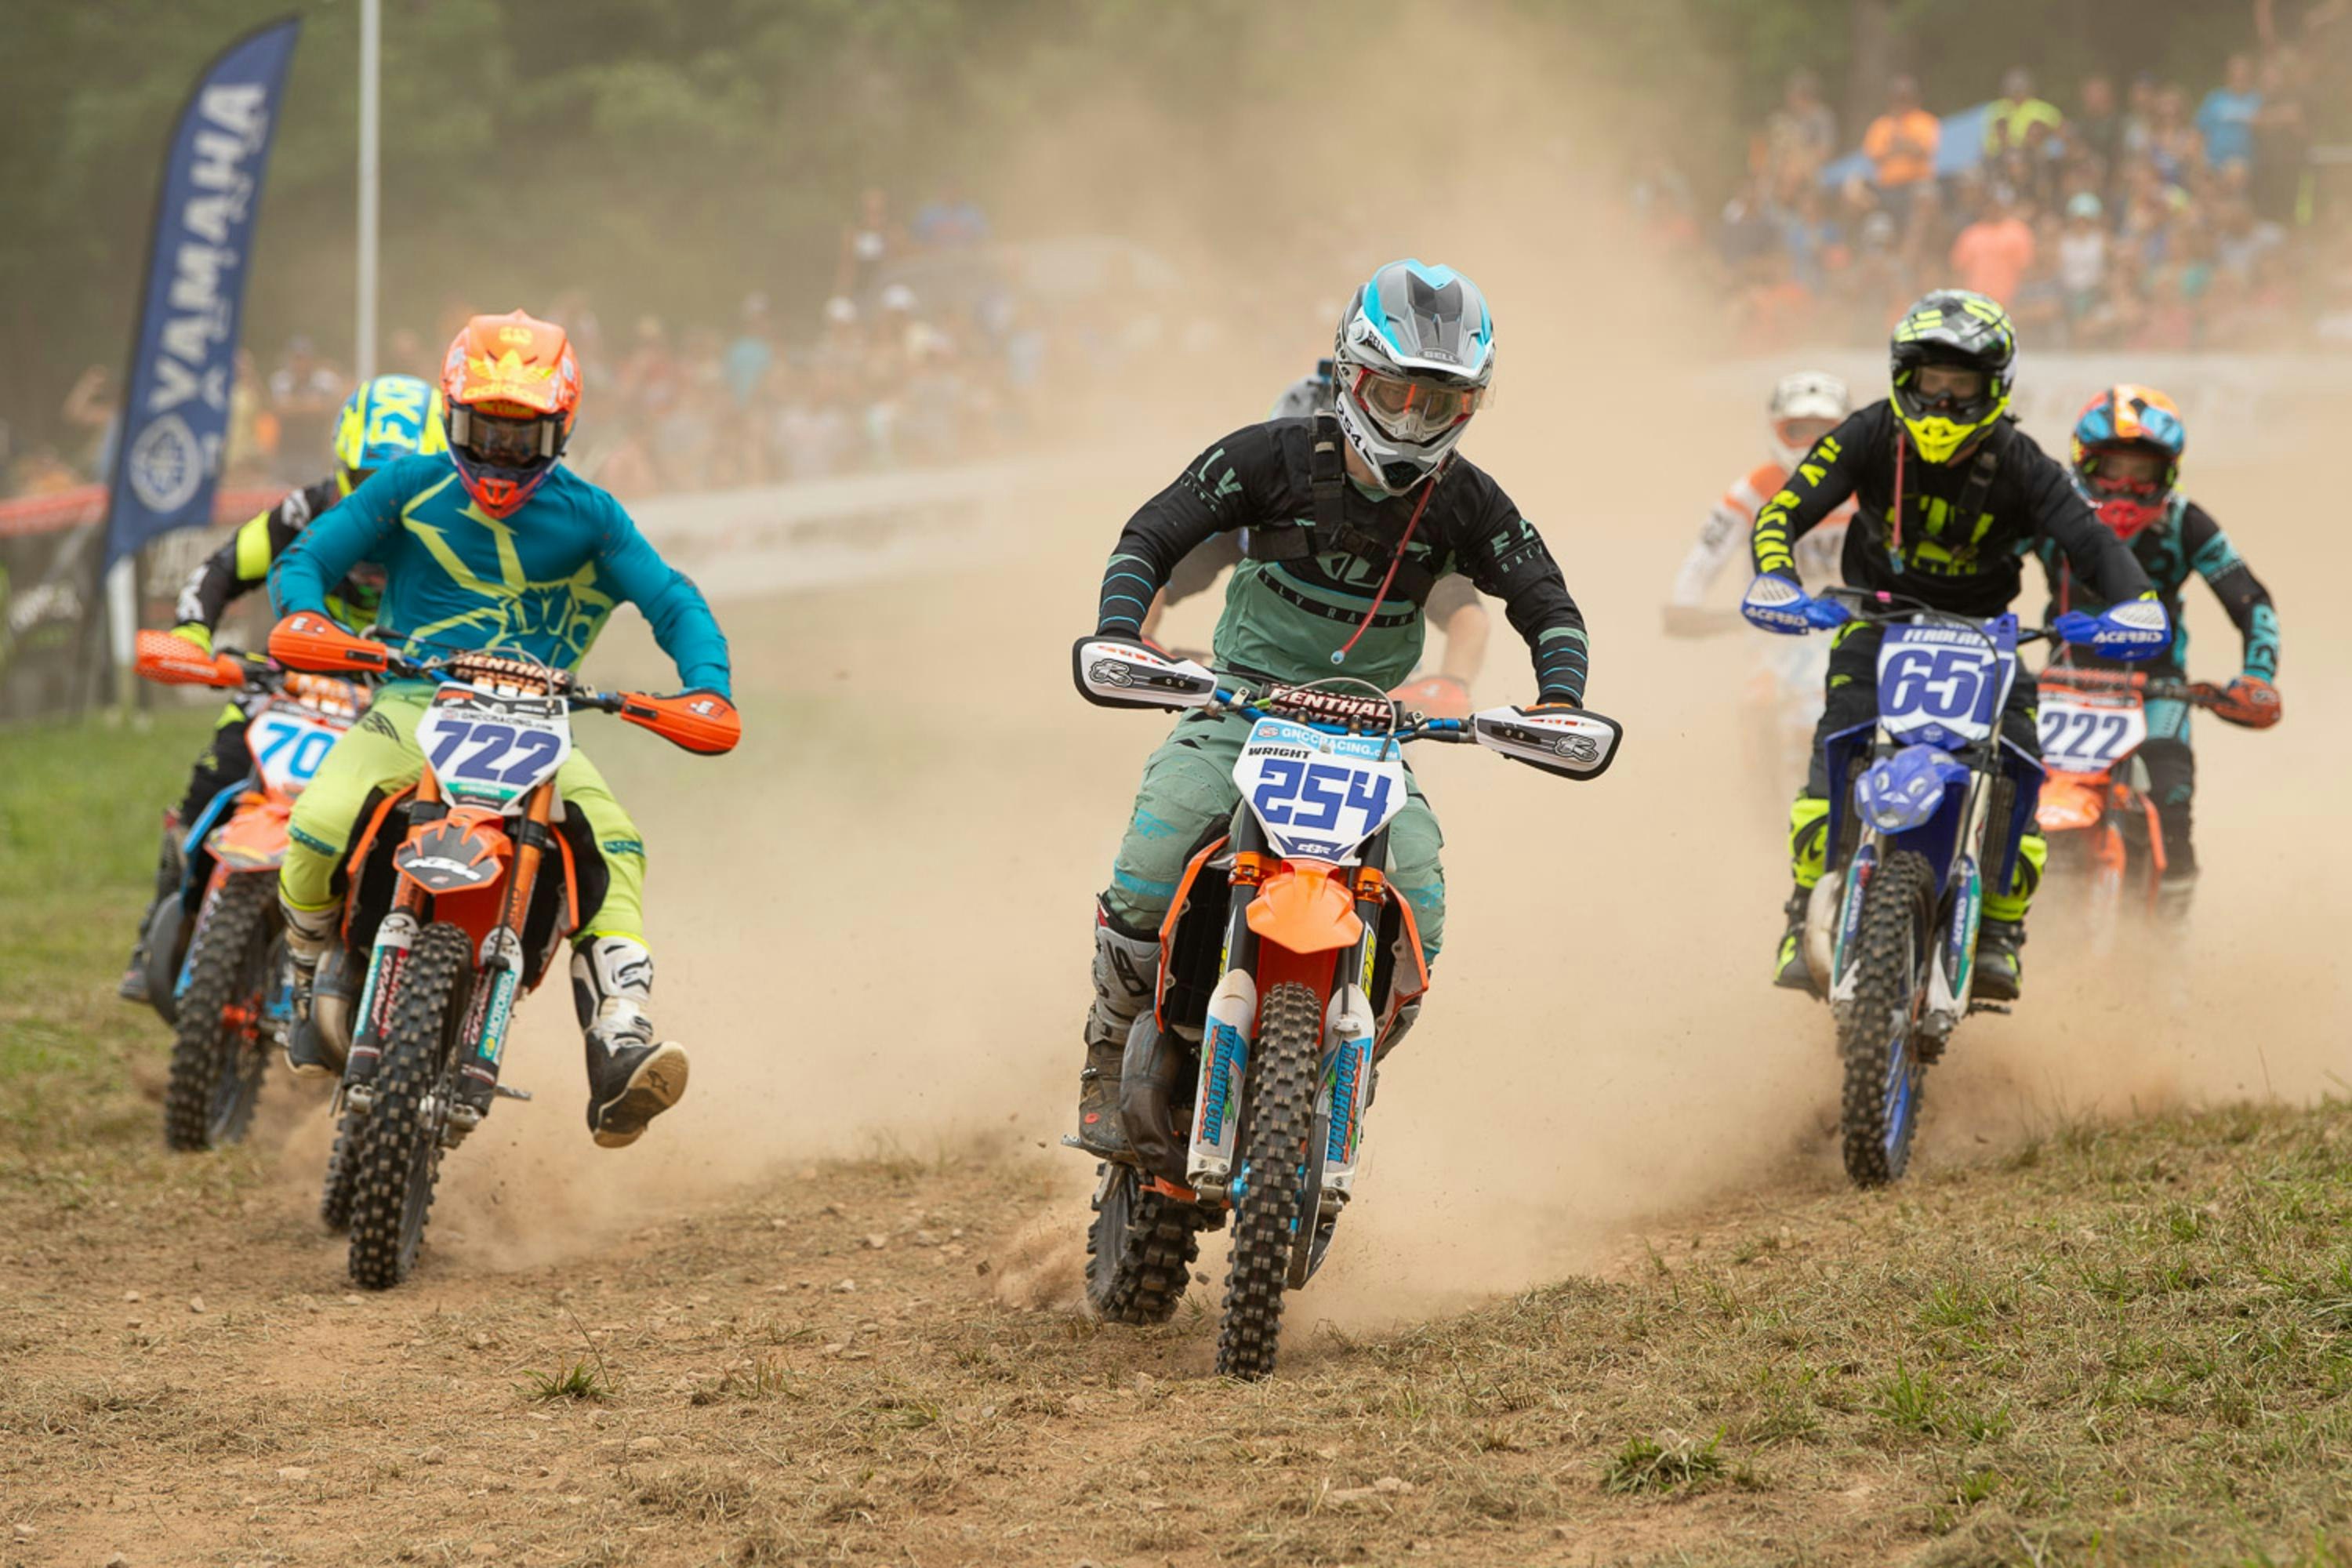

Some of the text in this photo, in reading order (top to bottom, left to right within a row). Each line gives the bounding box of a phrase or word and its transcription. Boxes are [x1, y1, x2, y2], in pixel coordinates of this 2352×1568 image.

[149, 83, 267, 410] YAMAHA
[1424, 351, 1456, 361] BELL
[367, 376, 427, 449] FXR
[1336, 401, 1363, 448] 254
[1197, 448, 1243, 498] LY
[1490, 518, 1534, 557] FL
[1263, 575, 1305, 607] FLY
[1745, 606, 1809, 627] ACERBIS
[2092, 630, 2163, 644] ACERBIS
[452, 651, 572, 684] RENTHAL
[1269, 687, 1392, 718] RENTHAL
[430, 720, 561, 786] 722
[1247, 747, 1311, 760] WRIGHT
[2040, 711, 2129, 760] 222
[1253, 758, 1392, 837] 254
[486, 972, 515, 1037] MOTOREX
[1203, 1025, 1236, 1146] WRIGHTCUT
[1327, 1040, 1356, 1163] WRIGHTCUT
